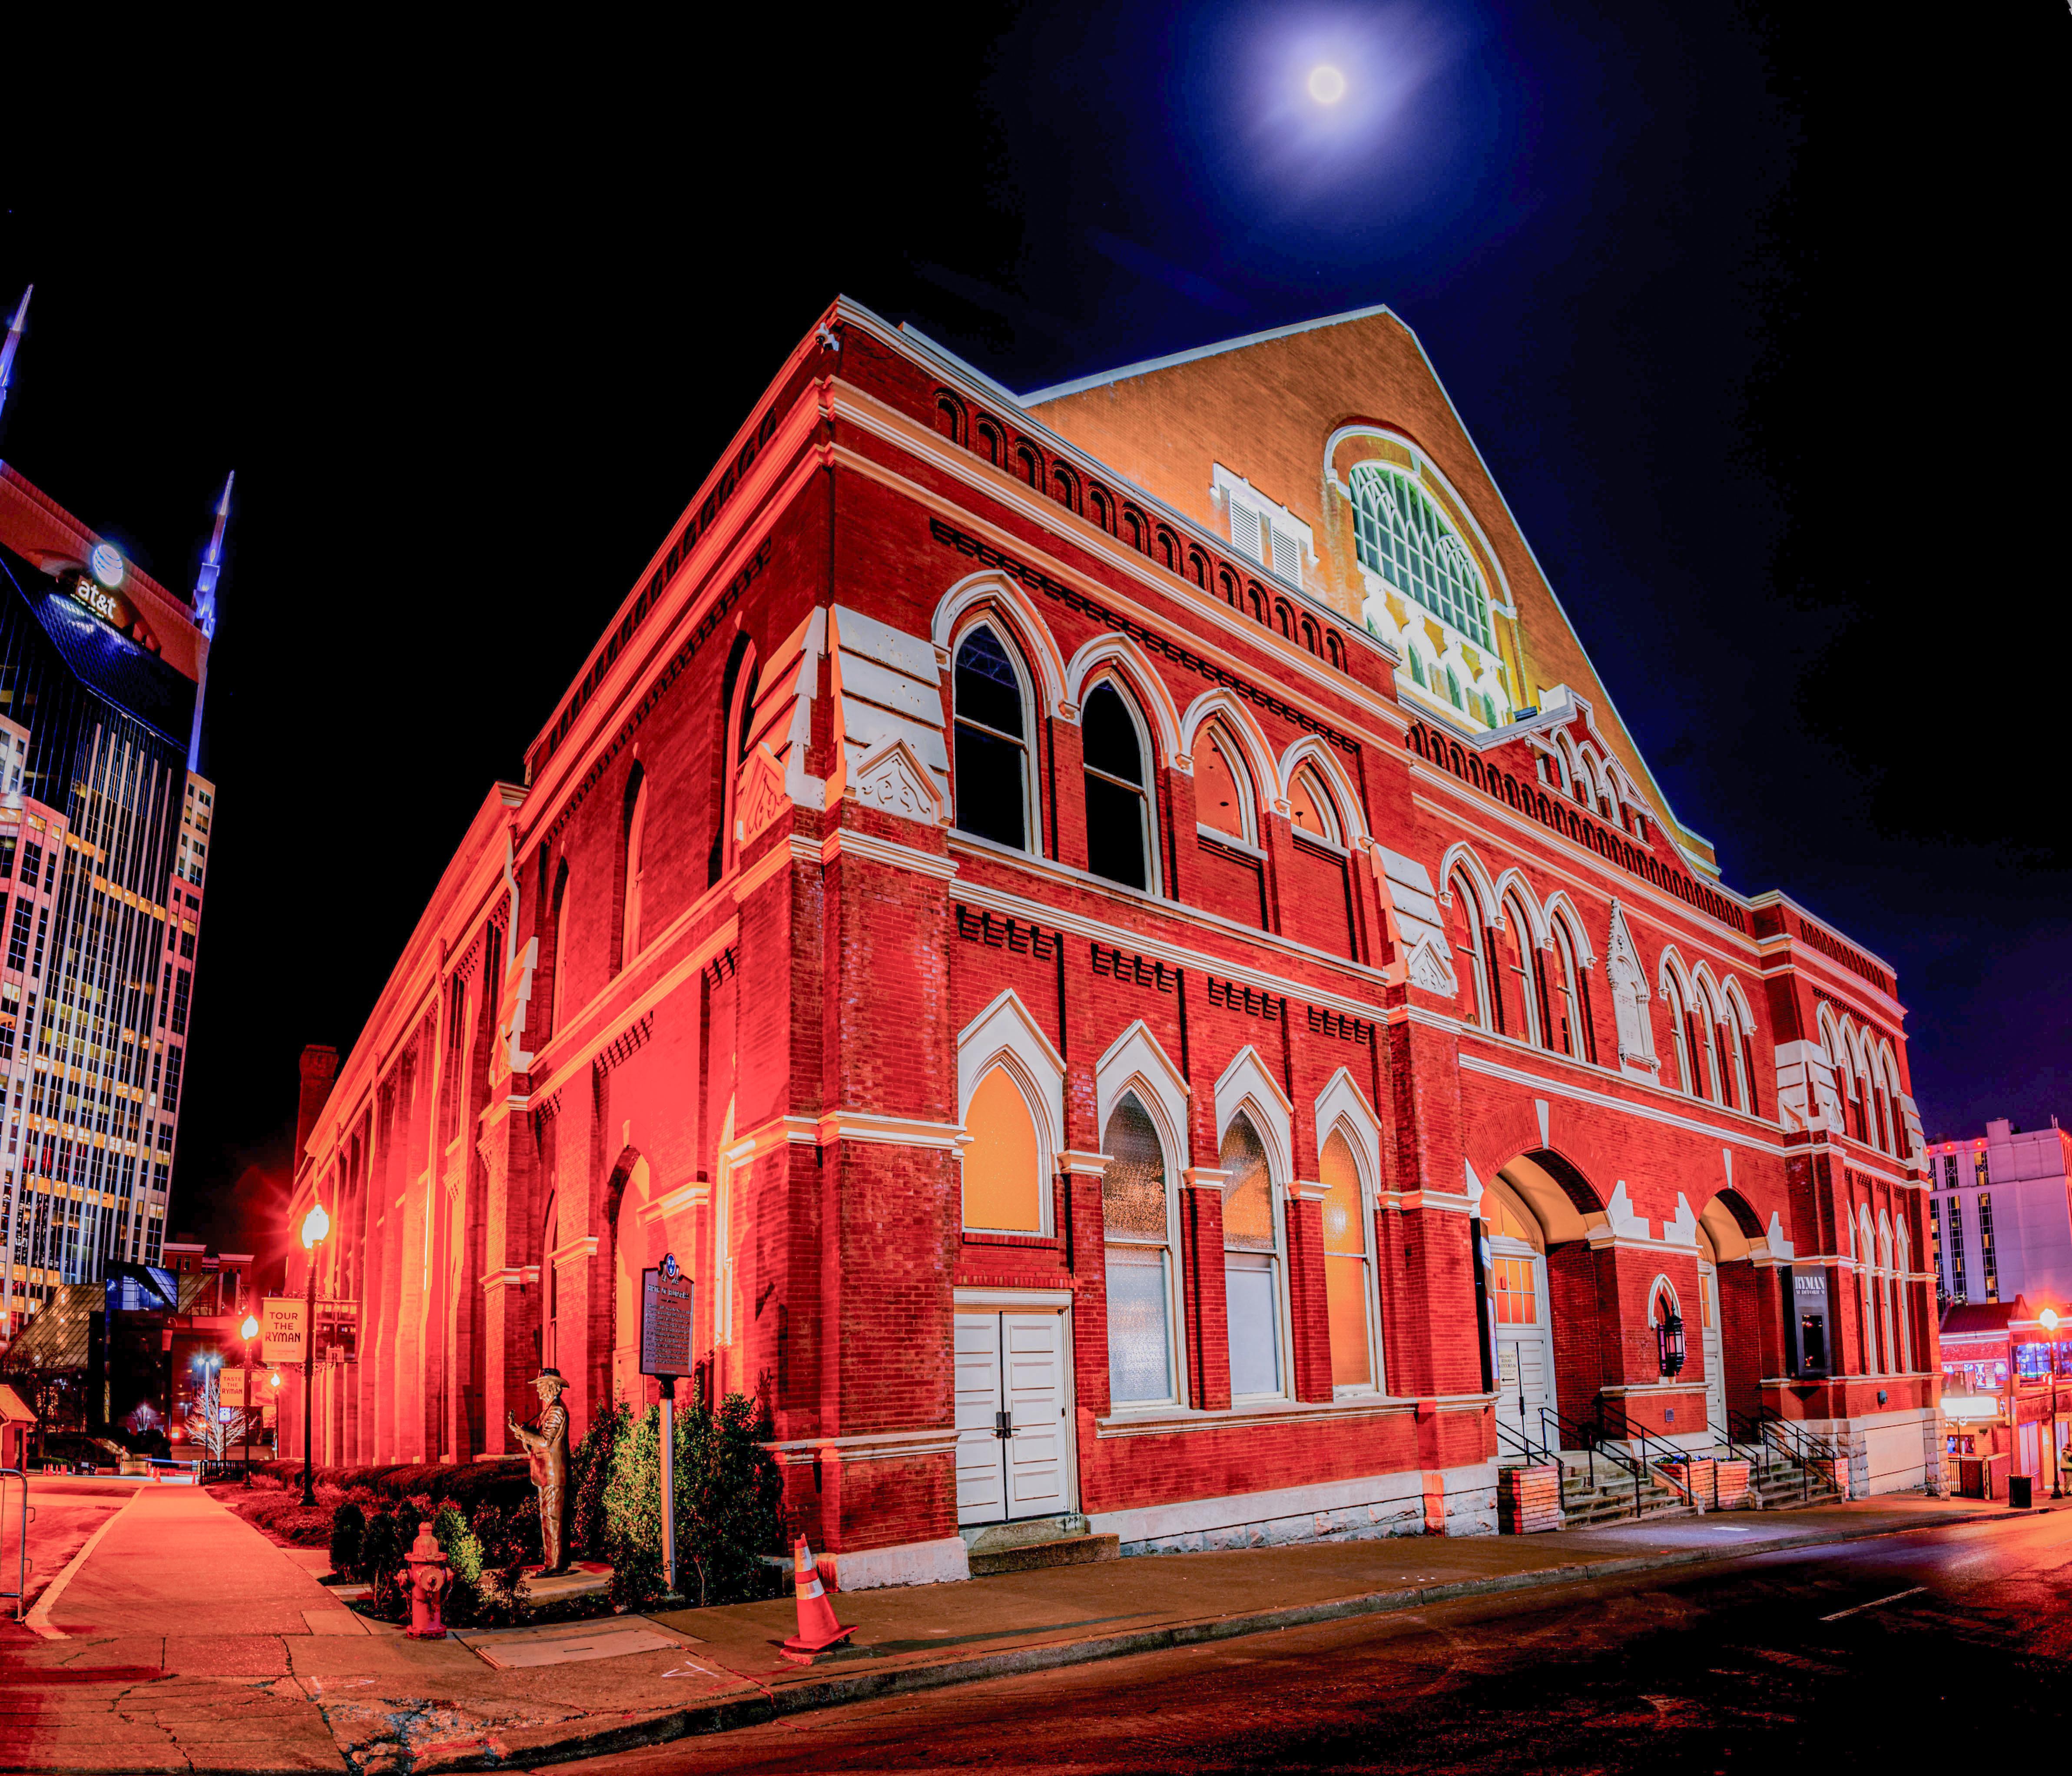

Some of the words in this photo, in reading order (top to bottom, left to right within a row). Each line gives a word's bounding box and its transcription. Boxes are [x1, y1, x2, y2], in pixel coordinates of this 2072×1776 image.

[78, 580, 116, 619] at&t
[1794, 1276, 1824, 1289] RYMAN
[648, 1284, 660, 1293] BIRTH
[265, 1332, 301, 1342] RYMAN
